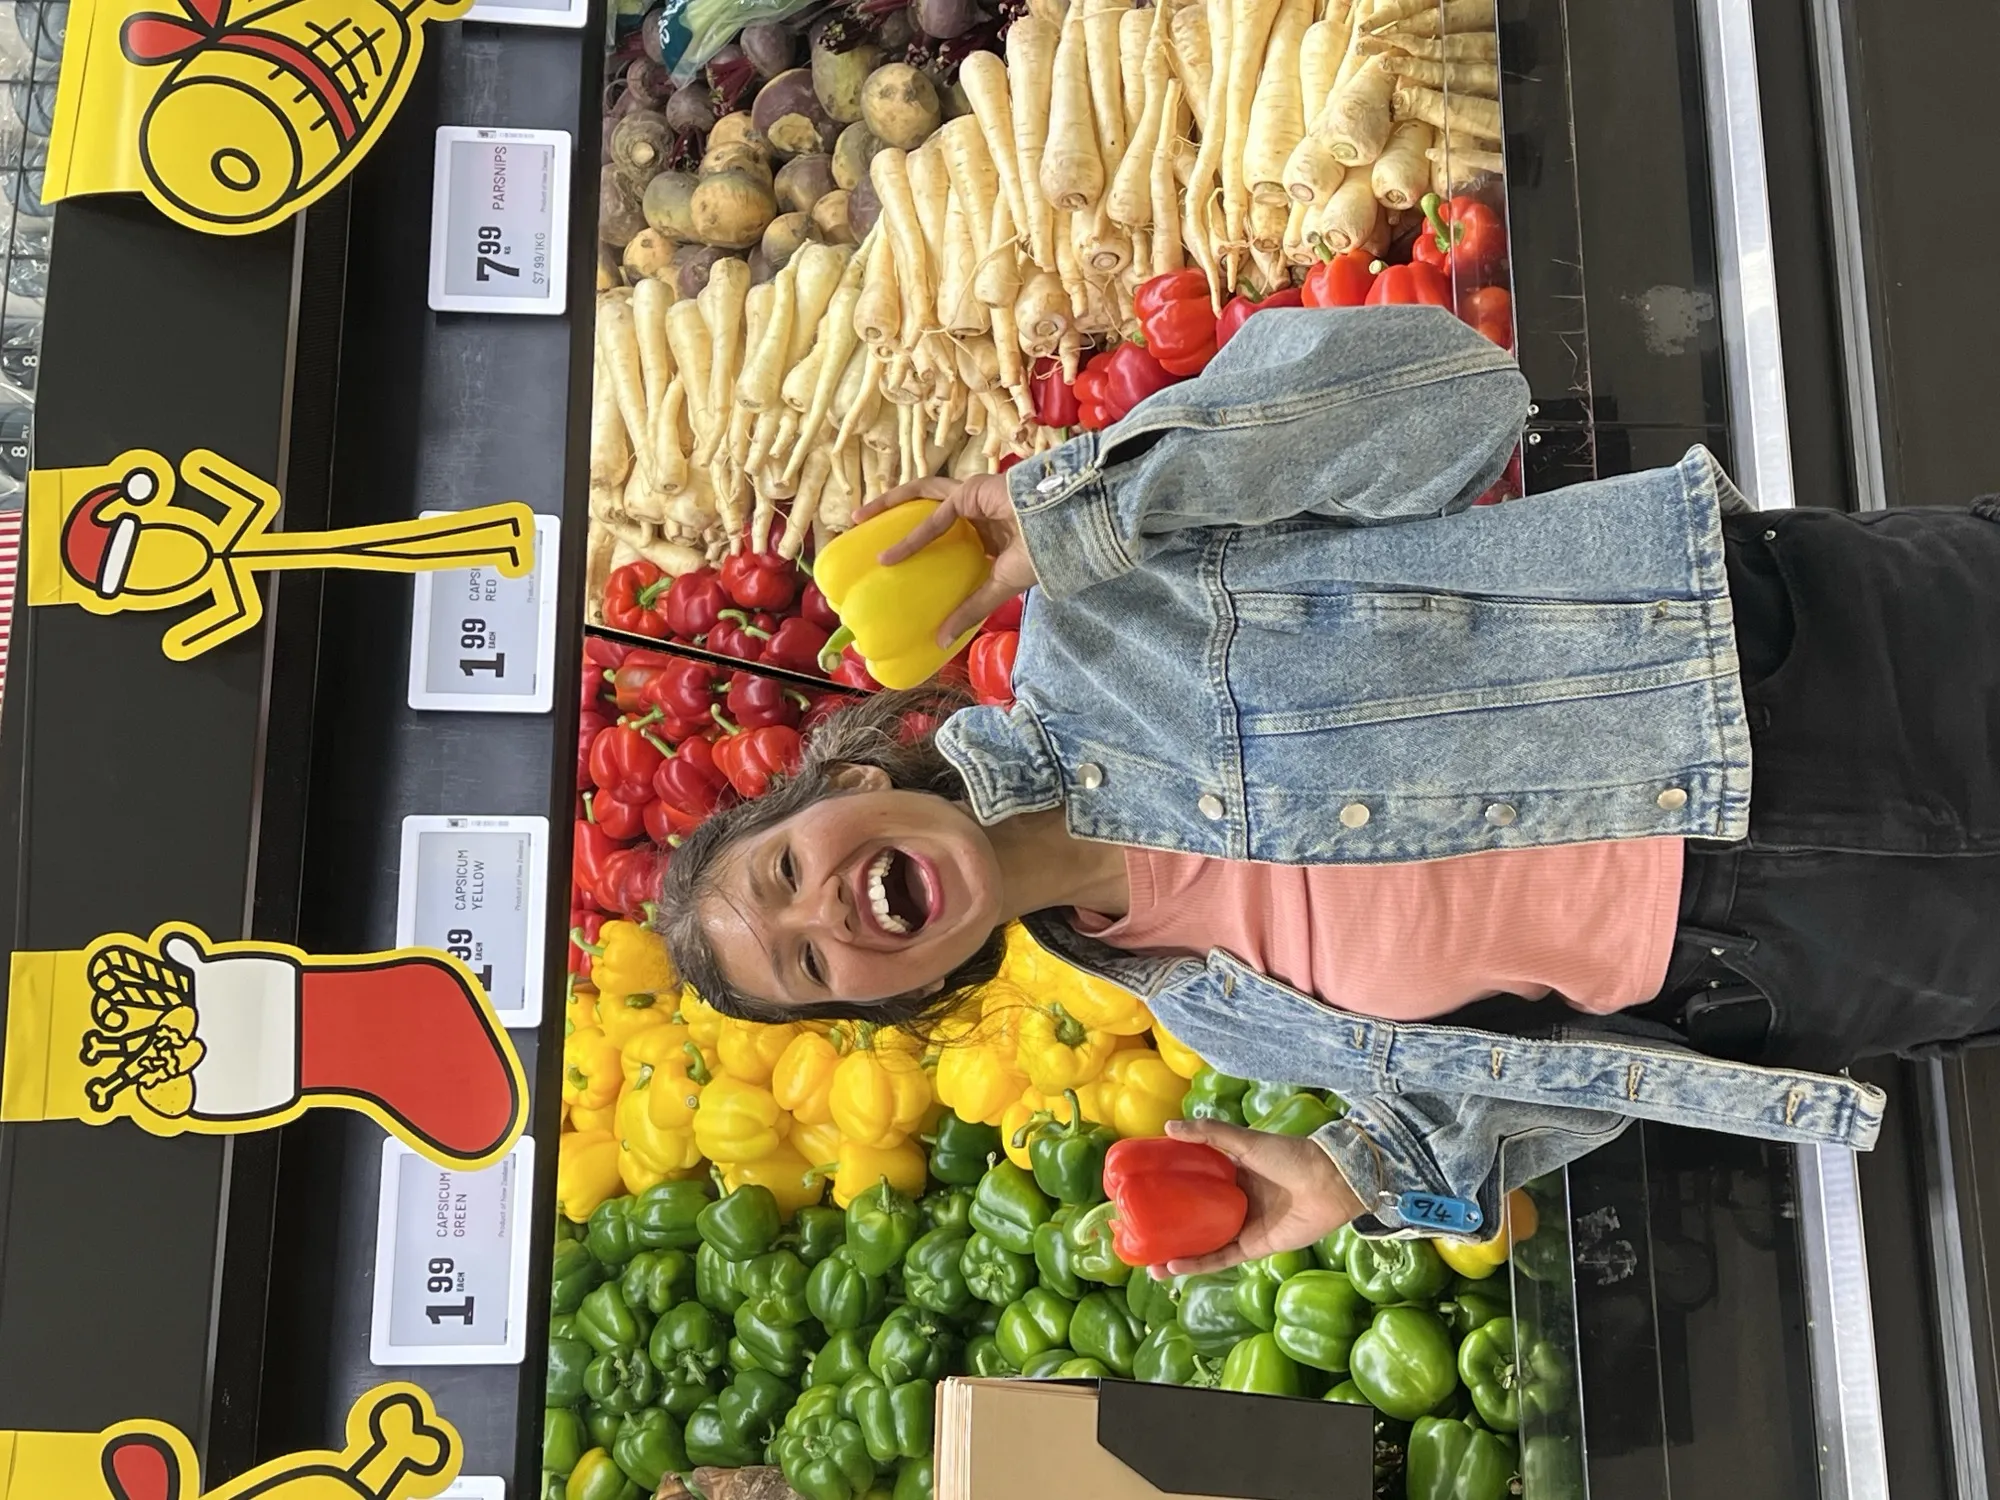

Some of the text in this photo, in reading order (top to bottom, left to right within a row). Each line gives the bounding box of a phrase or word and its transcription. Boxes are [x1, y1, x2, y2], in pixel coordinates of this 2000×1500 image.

[492, 146, 507, 211] PARSNIPS
[504, 246, 512, 255] KG
[532, 232, 546, 284] $7.99/1KG
[22, 355, 38, 367] 8
[11, 446, 27, 457] 8
[468, 568, 481, 601] CAPSI
[485, 579, 496, 602] RED
[488, 632, 496, 649] EACH
[454, 850, 469, 910] CAPSICUM
[472, 860, 484, 910] YELLOW
[474, 942, 483, 960] EACH
[436, 1172, 451, 1238] CAPSICUM
[454, 1194, 467, 1238] GREEN
[1413, 1200, 1452, 1222] 94
[457, 1272, 466, 1292] EACH
